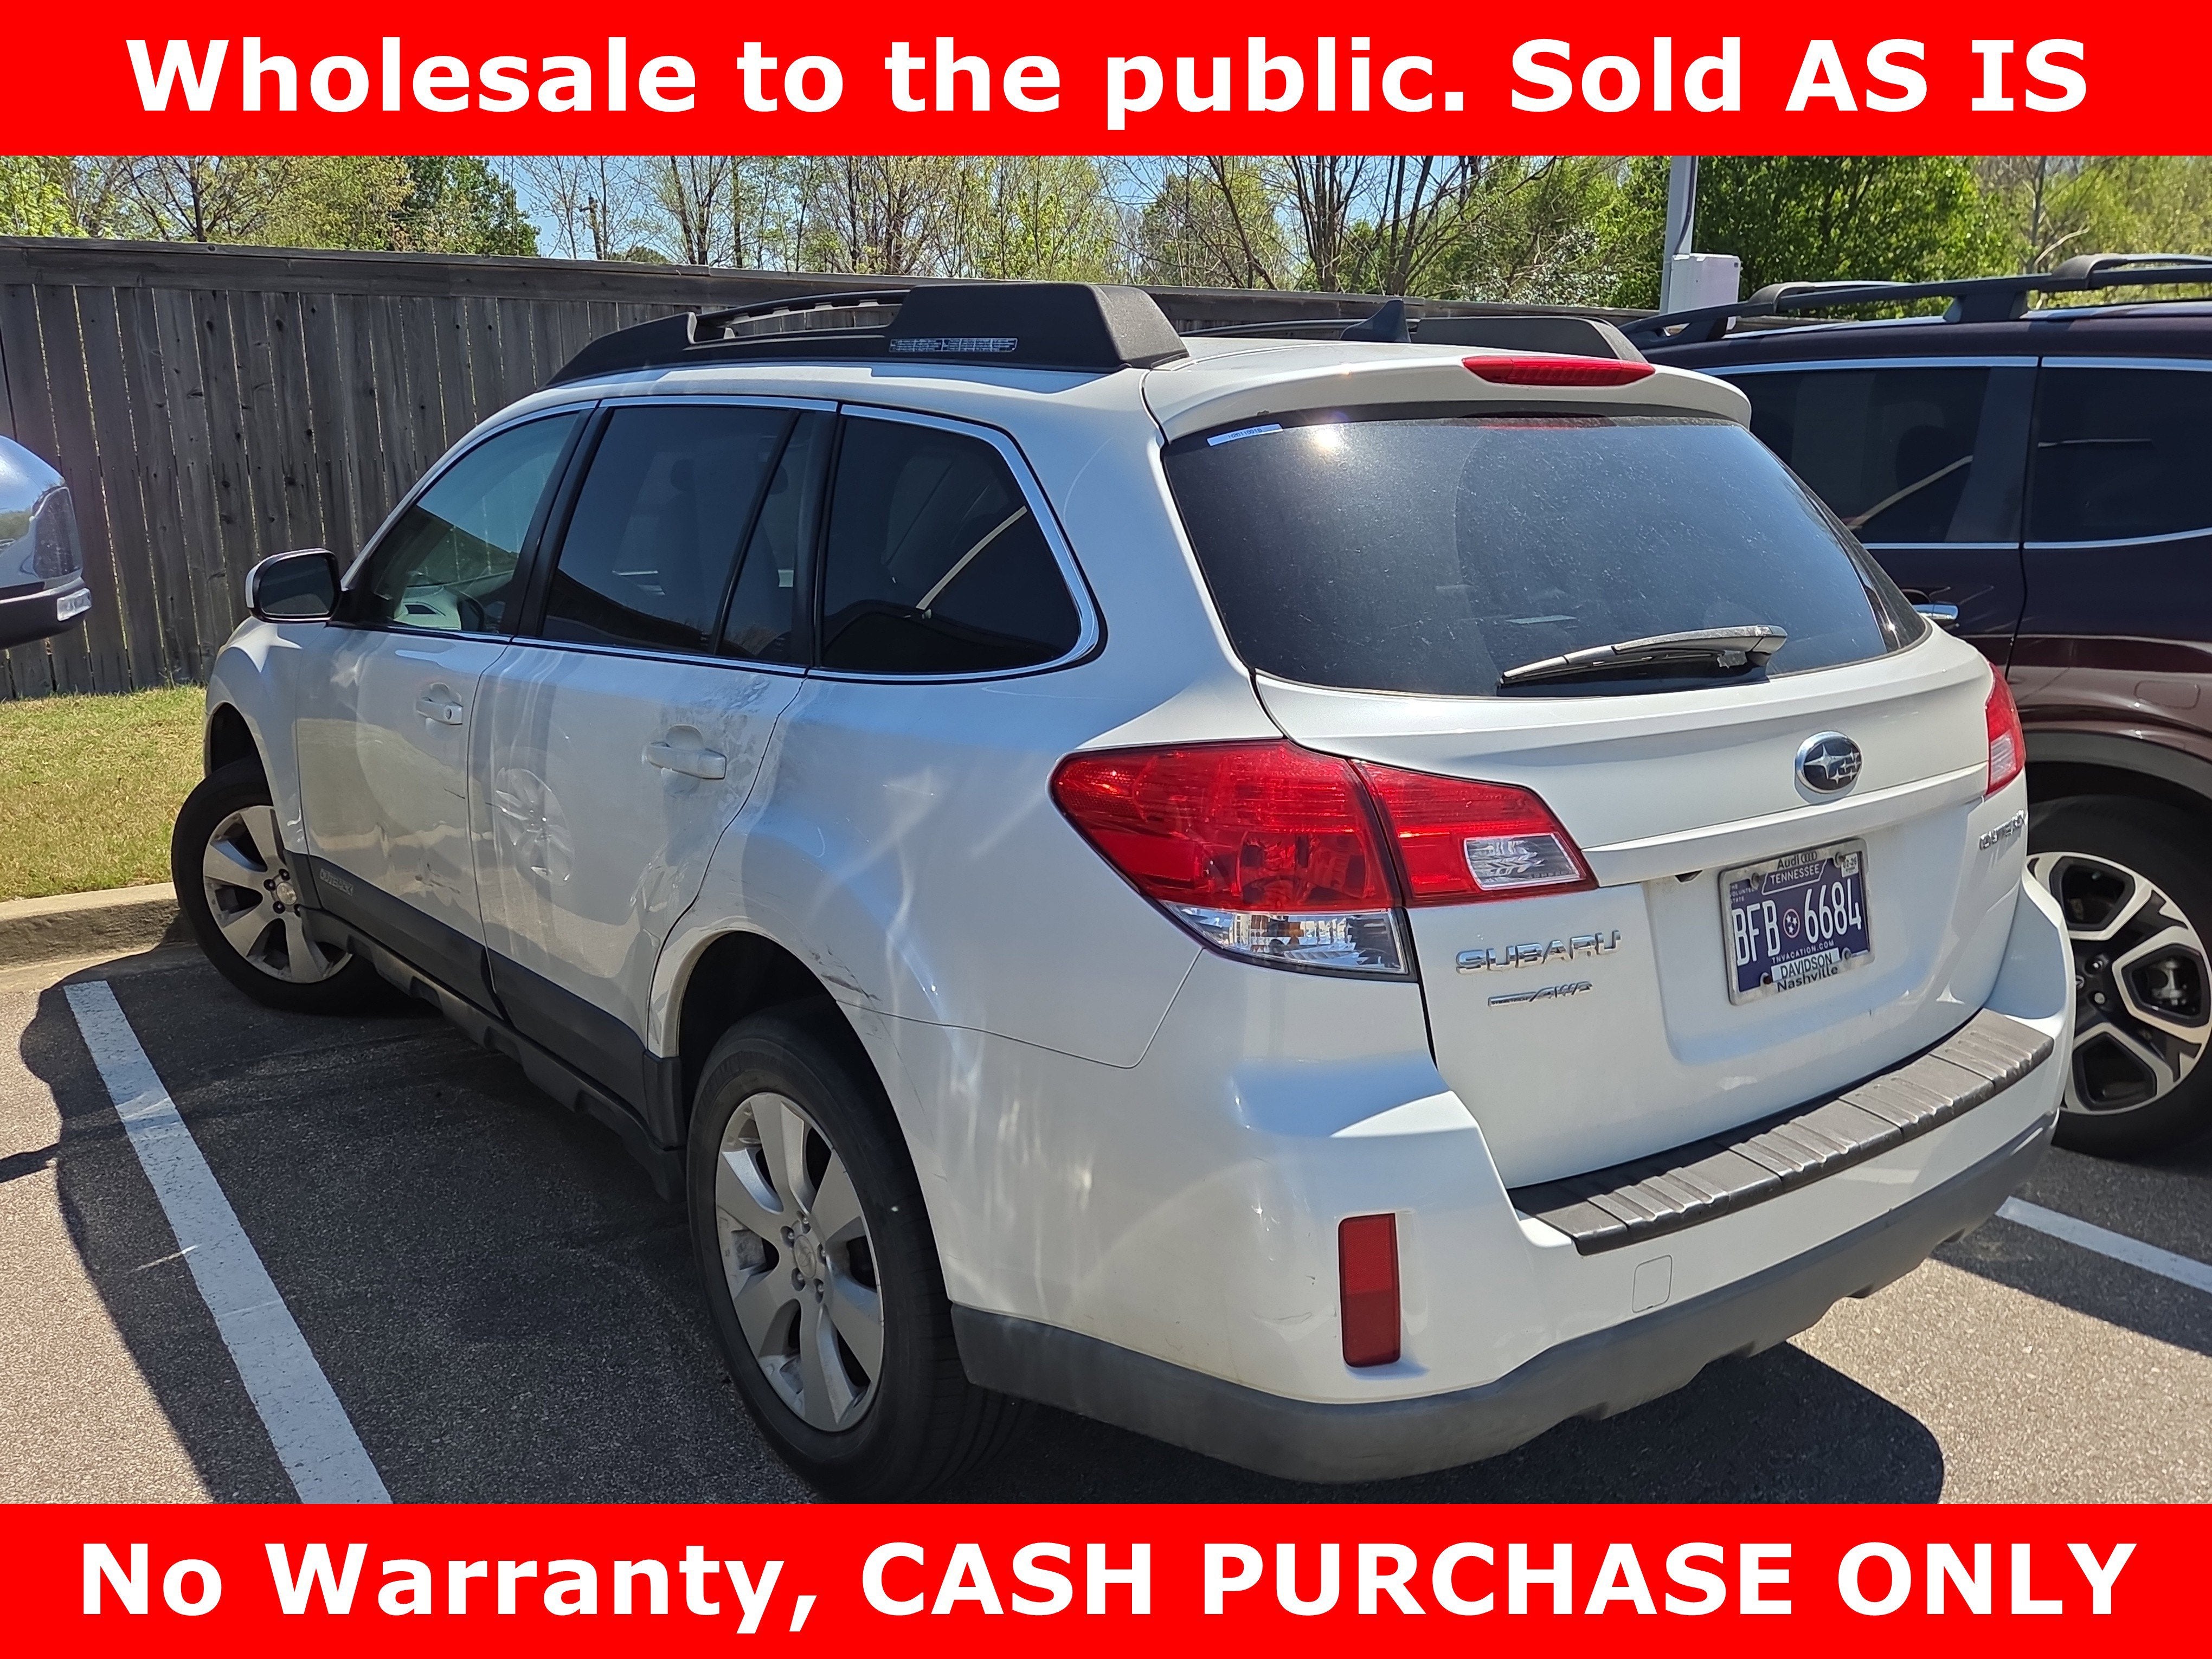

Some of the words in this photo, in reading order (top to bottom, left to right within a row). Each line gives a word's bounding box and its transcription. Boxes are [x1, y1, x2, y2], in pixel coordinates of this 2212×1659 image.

[1770, 864, 1820, 885] TENNESSEE
[1777, 854, 1800, 870] Audi
[1732, 899, 1781, 967] BFB
[1804, 878, 1862, 943] 6684
[1456, 929, 1622, 975] SUBARU
[1771, 940, 1835, 964] TNVACATION.COM
[1780, 951, 1833, 980] DAVIDSON
[1777, 965, 1838, 993] Nashville
